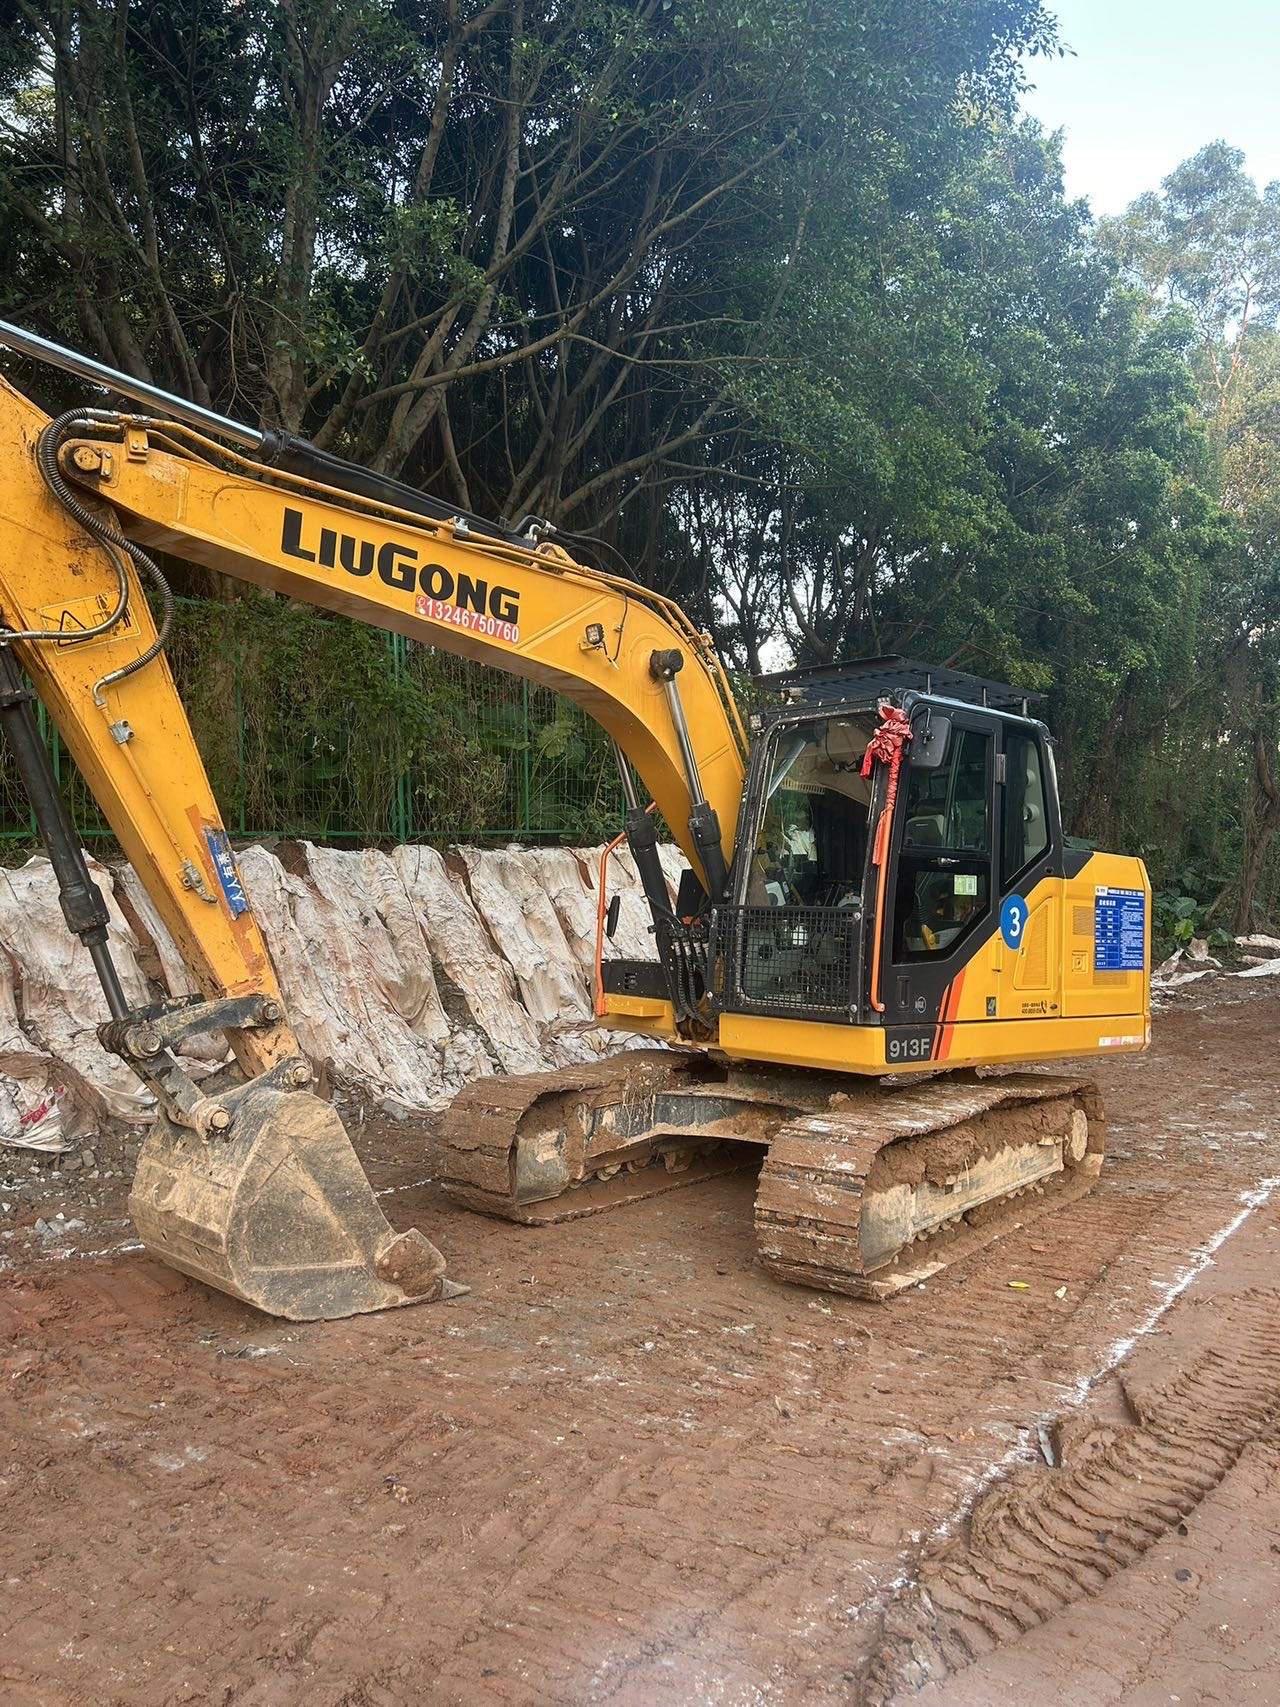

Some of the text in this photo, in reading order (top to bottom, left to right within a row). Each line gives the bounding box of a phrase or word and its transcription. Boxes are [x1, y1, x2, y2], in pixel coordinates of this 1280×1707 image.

[426, 599, 520, 644] 13246750760
[1009, 906, 1021, 937] 3
[889, 1038, 931, 1058] 913F
